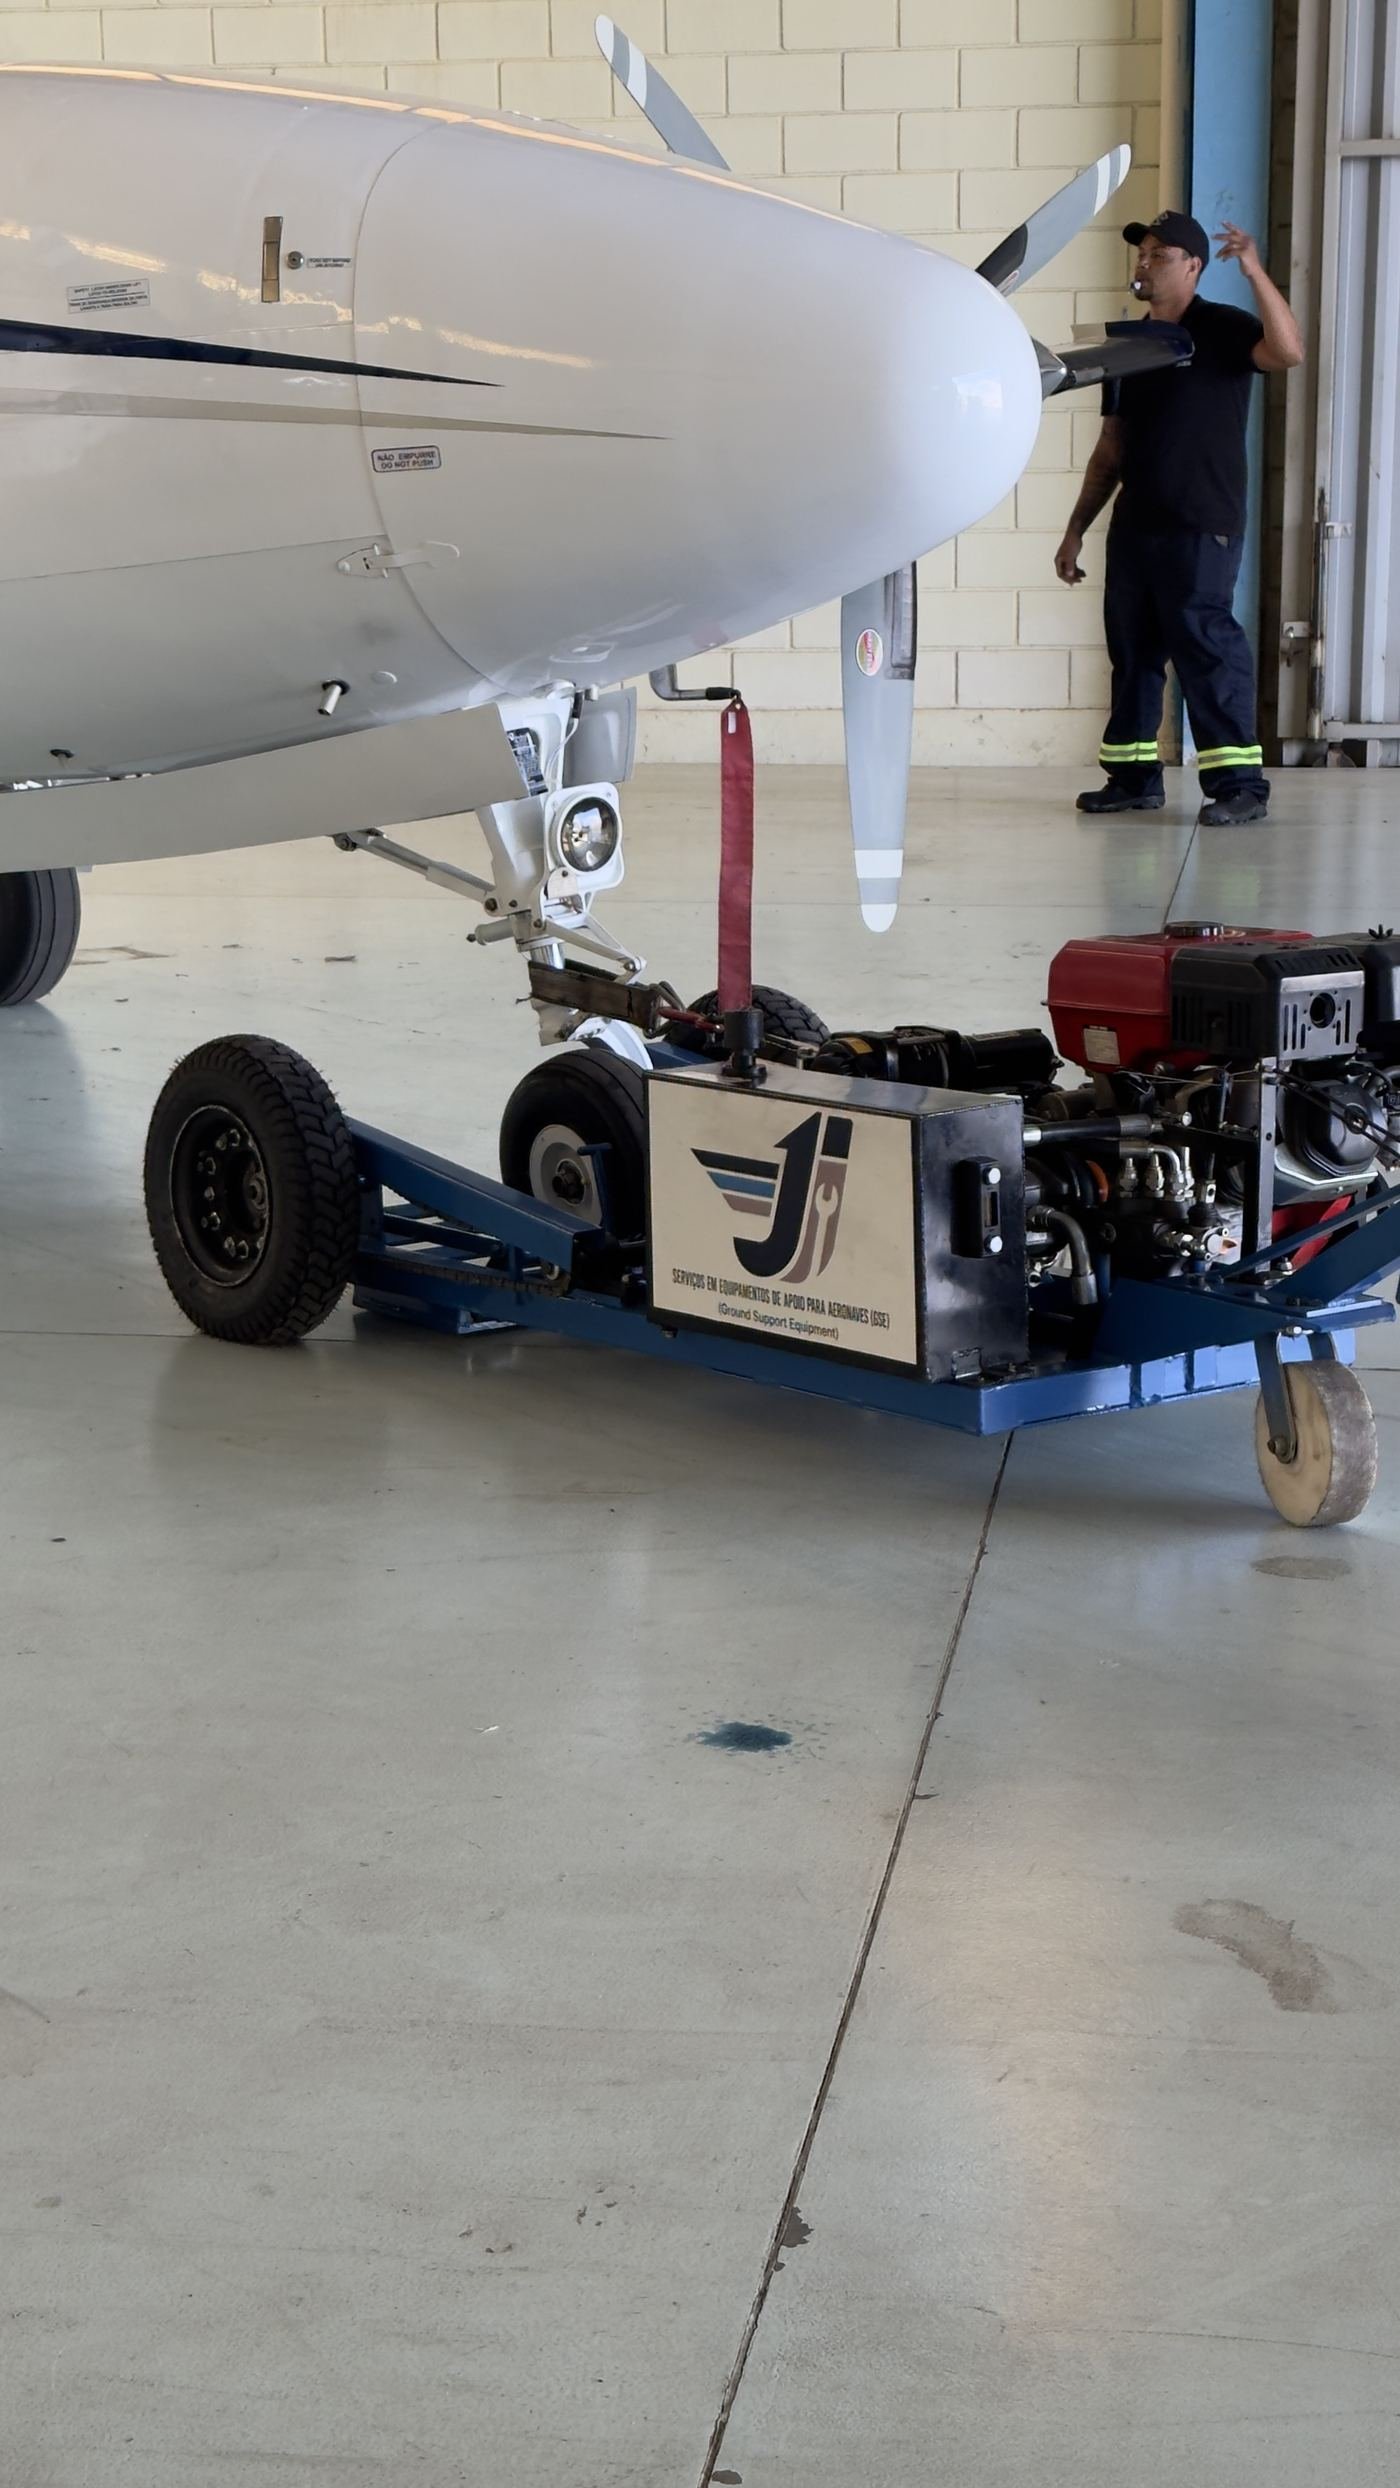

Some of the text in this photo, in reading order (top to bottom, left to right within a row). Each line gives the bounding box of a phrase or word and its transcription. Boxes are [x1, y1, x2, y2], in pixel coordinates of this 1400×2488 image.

[394, 460, 410, 468] NOT
[672, 1268, 890, 1331] SERVIÇOS EM EQUIPAMENTOS DE APOIO PARA AERONAVES (GSE)
[719, 1302, 839, 1340] (Ground Support Equipment)
